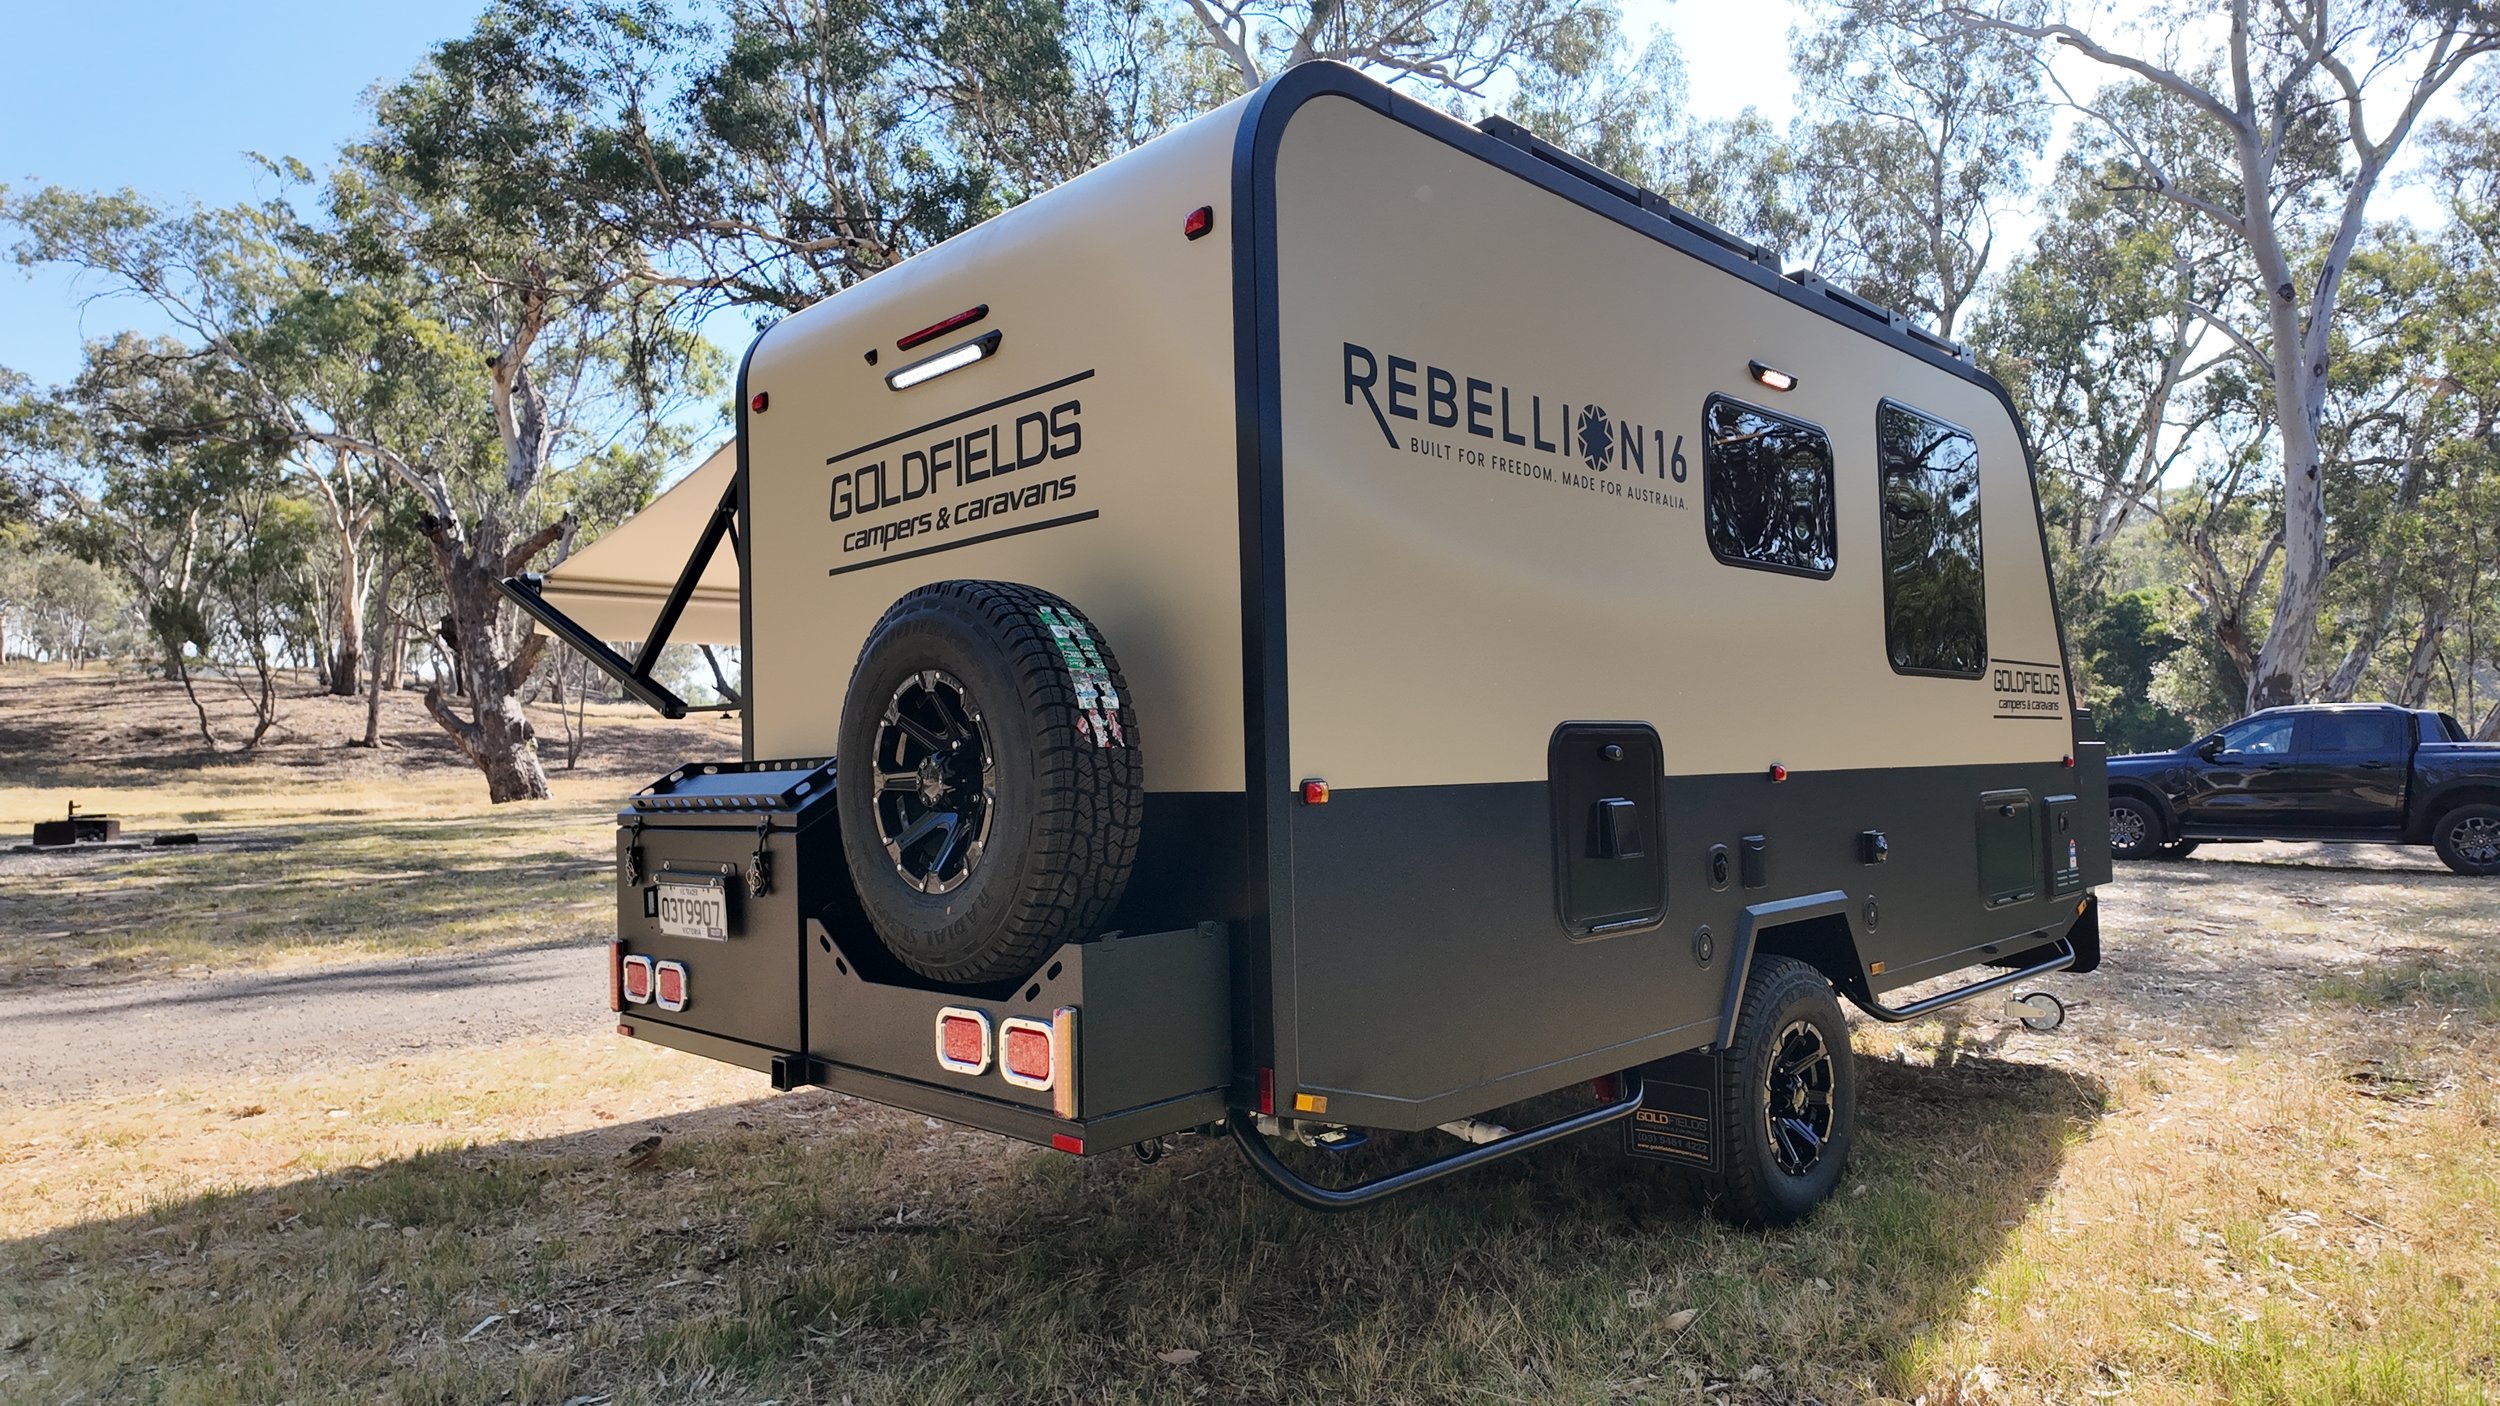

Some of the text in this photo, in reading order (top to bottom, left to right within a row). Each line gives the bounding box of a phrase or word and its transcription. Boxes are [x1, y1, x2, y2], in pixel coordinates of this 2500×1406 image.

[1343, 341, 1688, 484] REBELLION 16
[829, 399, 1081, 522] GOLDFIELDS
[1410, 437, 1689, 511] BUILT FOR FREEDOM. MADE FOR AUSTRALIA.
[843, 474, 1077, 552] campers & caravans
[1994, 669, 2060, 695] GOLDFIELDS
[1998, 699, 2026, 712] campers
[2031, 701, 2060, 711] caravans
[662, 897, 720, 927] 03T9907
[1636, 1111, 1707, 1132] GOLDFIELDS
